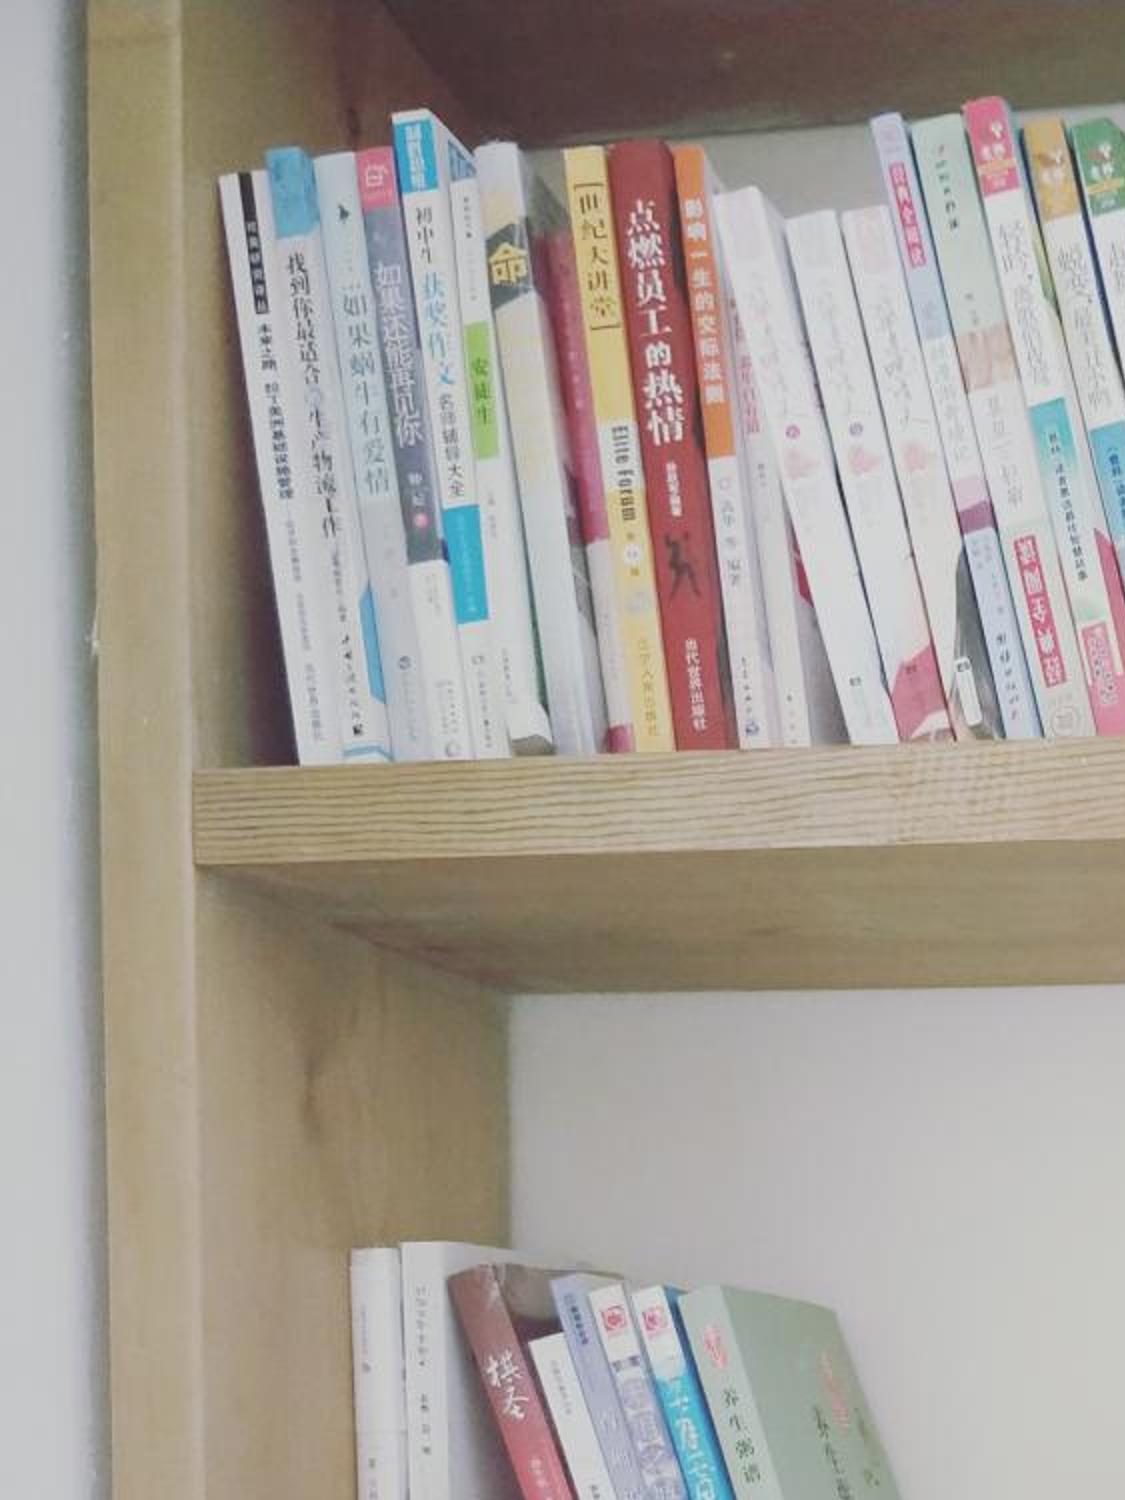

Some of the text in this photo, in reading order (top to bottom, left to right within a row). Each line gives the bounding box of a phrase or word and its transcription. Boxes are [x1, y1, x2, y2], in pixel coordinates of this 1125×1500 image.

[489, 241, 528, 285] 命
[578, 193, 619, 322] 世纪大讲堂
[626, 198, 686, 446] 点燃员工的热情
[343, 293, 390, 495] 如果蜗牛有爱情
[485, 1348, 530, 1420] 棋圣
